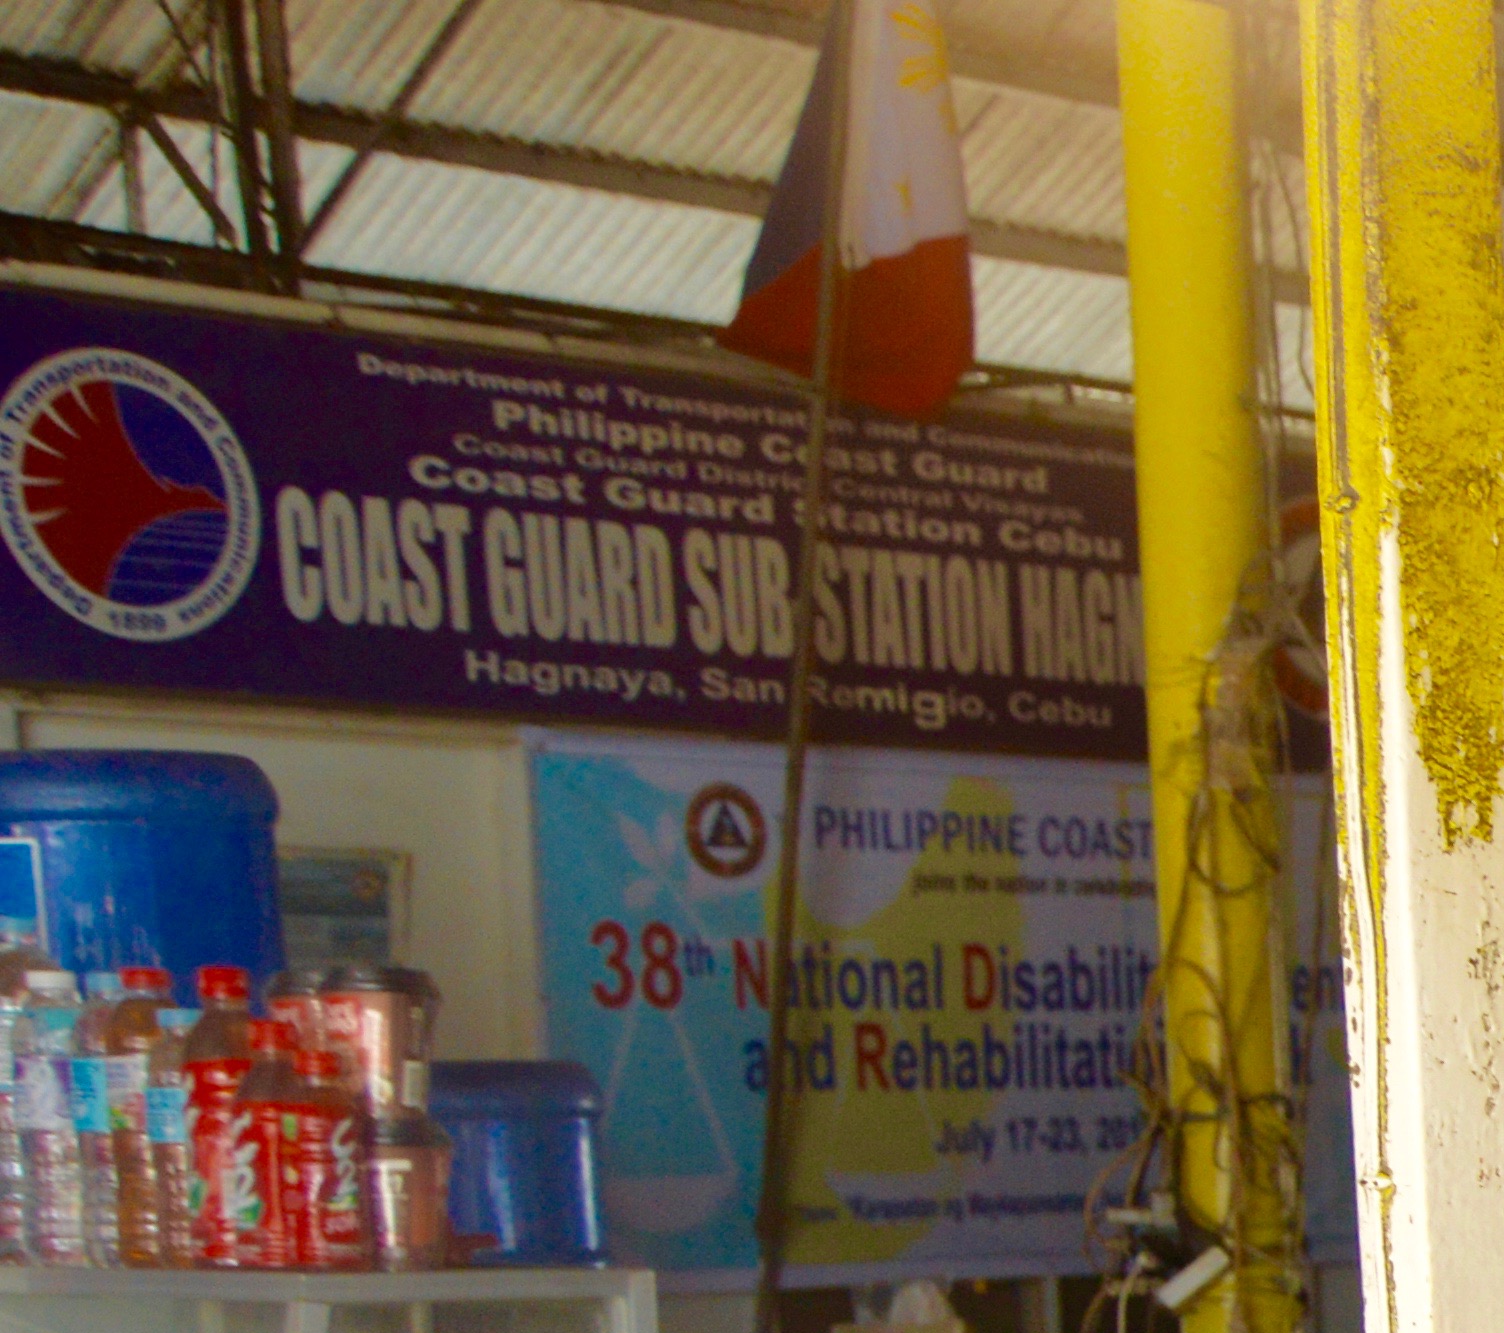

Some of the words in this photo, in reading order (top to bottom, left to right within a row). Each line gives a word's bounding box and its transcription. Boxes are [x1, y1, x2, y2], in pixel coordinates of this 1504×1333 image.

[355, 350, 566, 400] Department
[574, 382, 608, 405] of
[453, 432, 566, 468] Coast
[574, 445, 690, 483] Guard
[490, 399, 746, 459] Philippine
[911, 450, 1050, 496] Guard
[408, 453, 587, 506] Coast
[602, 475, 777, 526] Guard
[999, 518, 1125, 562] Cebu
[276, 484, 472, 635] COAST
[482, 505, 678, 650] GUARD
[682, 526, 796, 659] SUB
[811, 537, 1013, 678] STATION
[463, 648, 689, 702] Hagnaya,
[700, 665, 786, 706] San
[1007, 689, 1113, 729] Cebu
[813, 803, 1030, 859] PHILIPPINE
[1036, 813, 1156, 862] COAST
[961, 941, 1160, 1015] Disabilit
